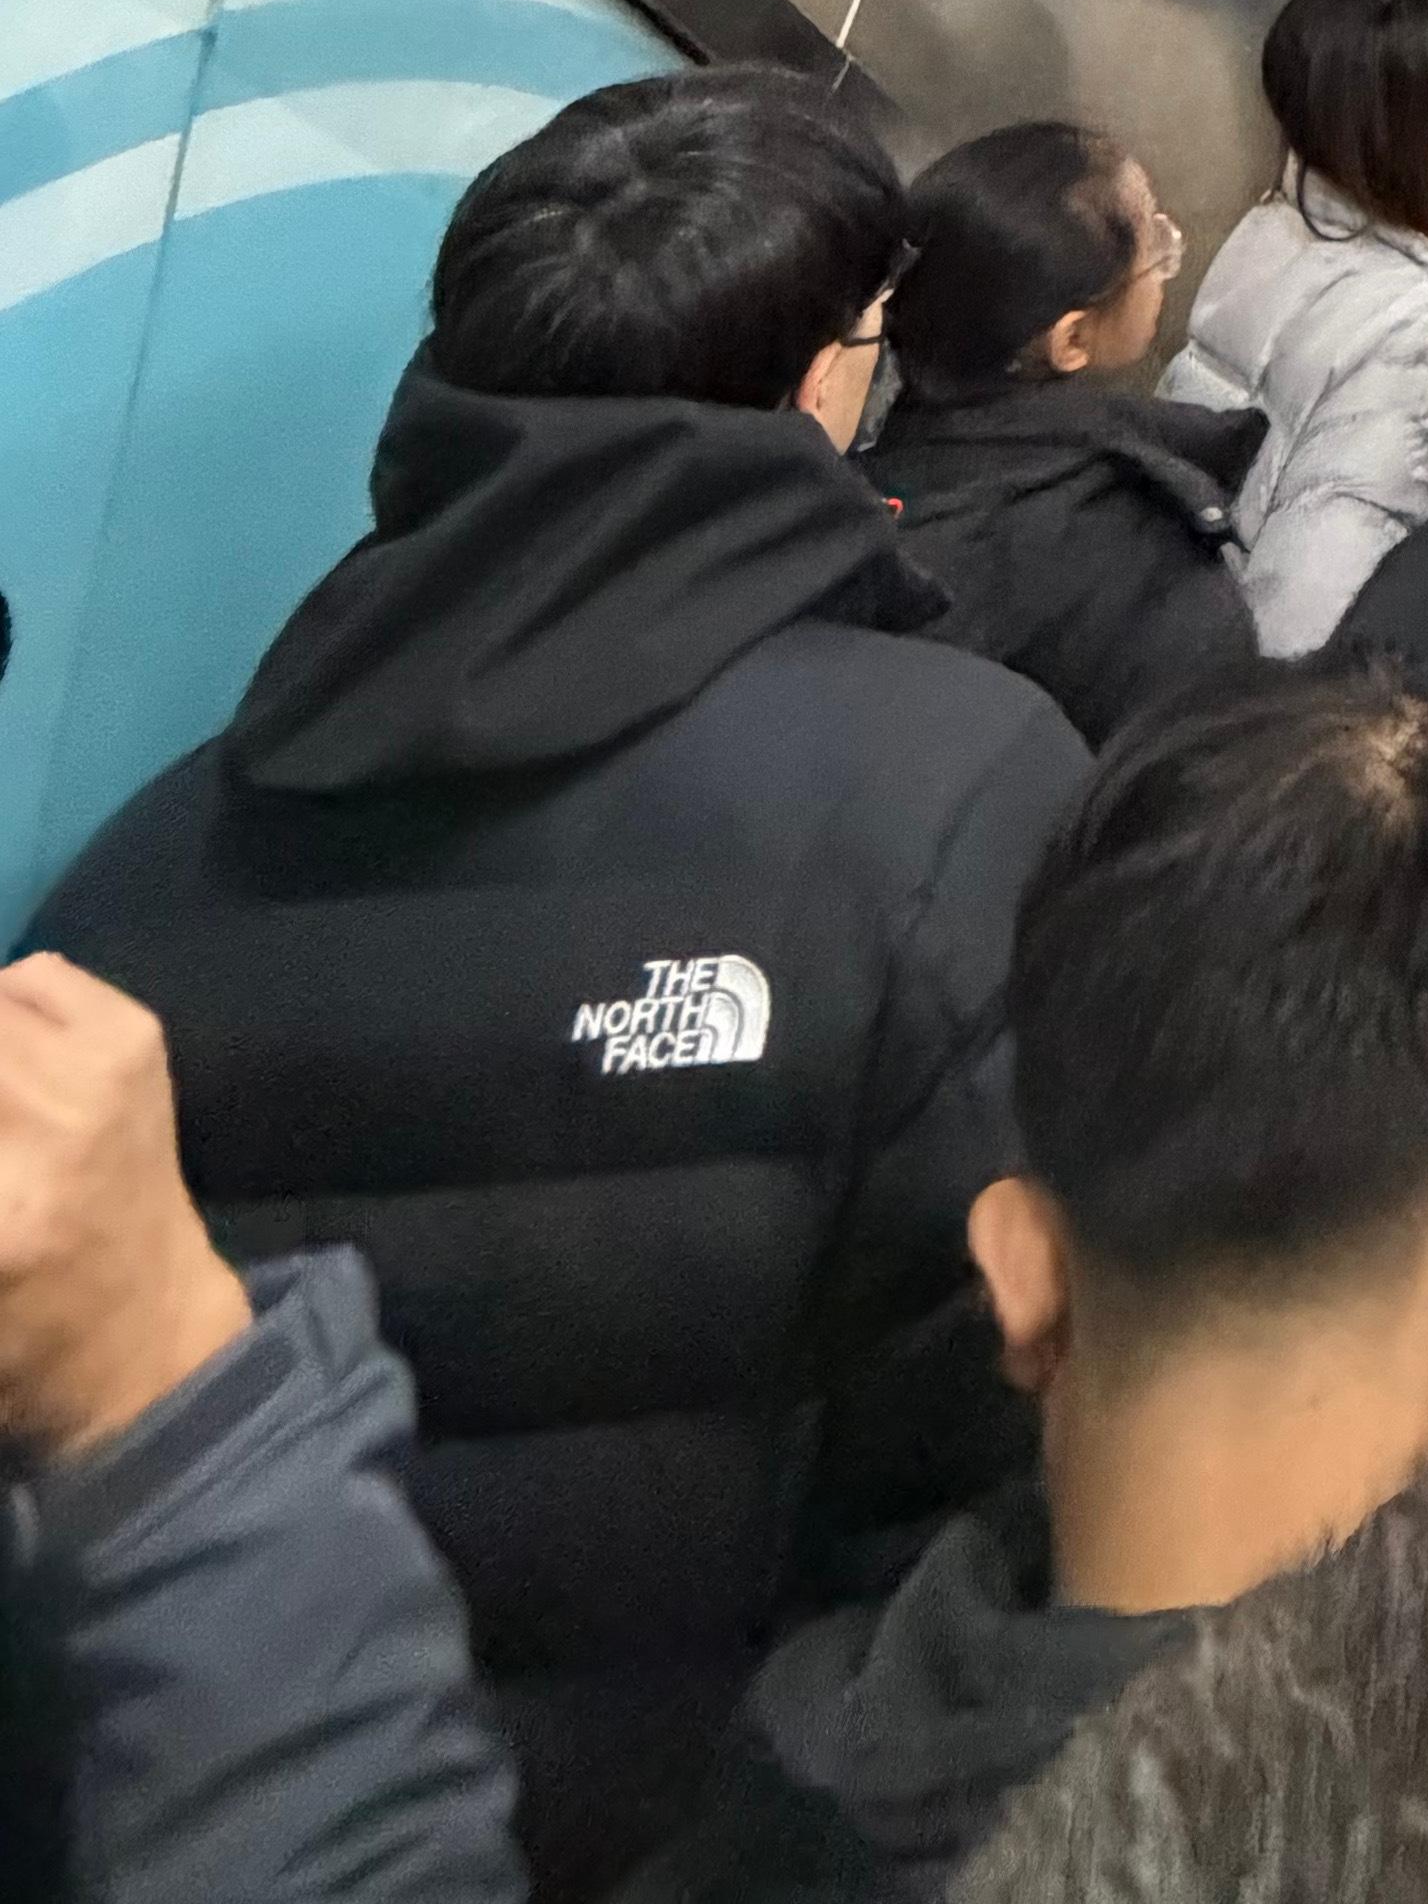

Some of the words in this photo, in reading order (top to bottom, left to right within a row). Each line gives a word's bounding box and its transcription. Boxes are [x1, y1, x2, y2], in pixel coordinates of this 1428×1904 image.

[643, 956, 720, 998] THE
[572, 992, 708, 1042] NORTH
[602, 1028, 702, 1074] FACE
